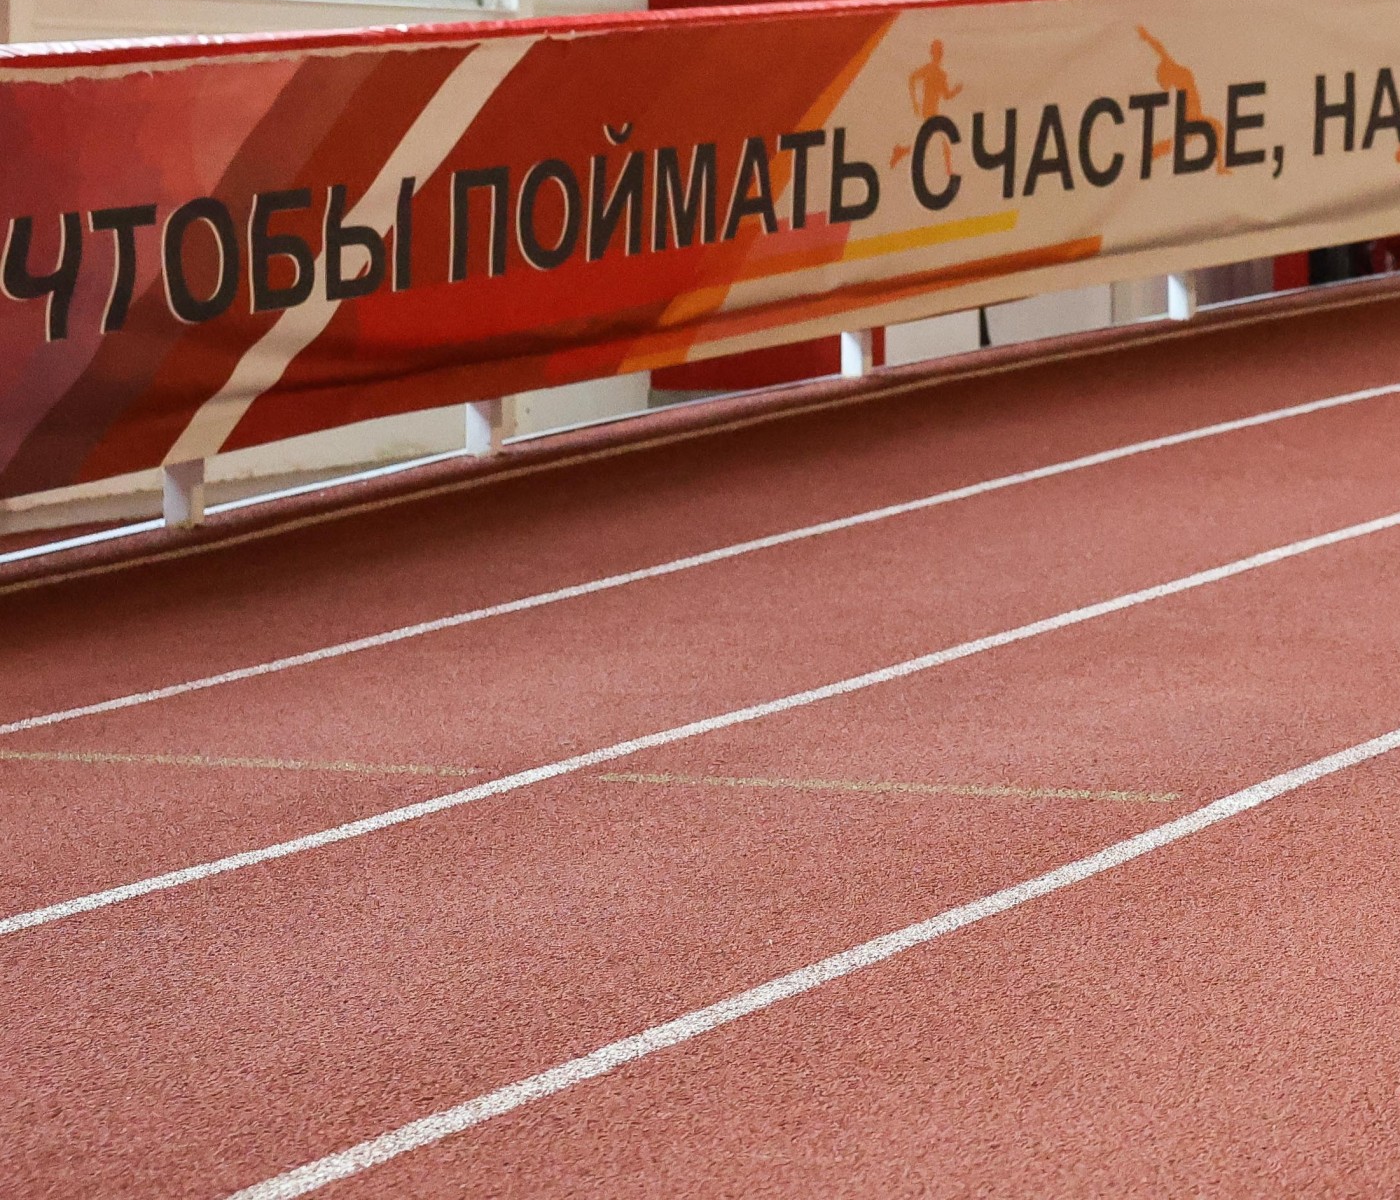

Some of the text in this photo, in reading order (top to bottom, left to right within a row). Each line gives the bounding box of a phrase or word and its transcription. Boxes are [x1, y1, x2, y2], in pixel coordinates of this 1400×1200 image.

[1, 178, 415, 342] ЧТОБЫ
[449, 122, 880, 283] ПОЙМАТЬ
[910, 81, 1284, 211] СЧАСТЬЕ,
